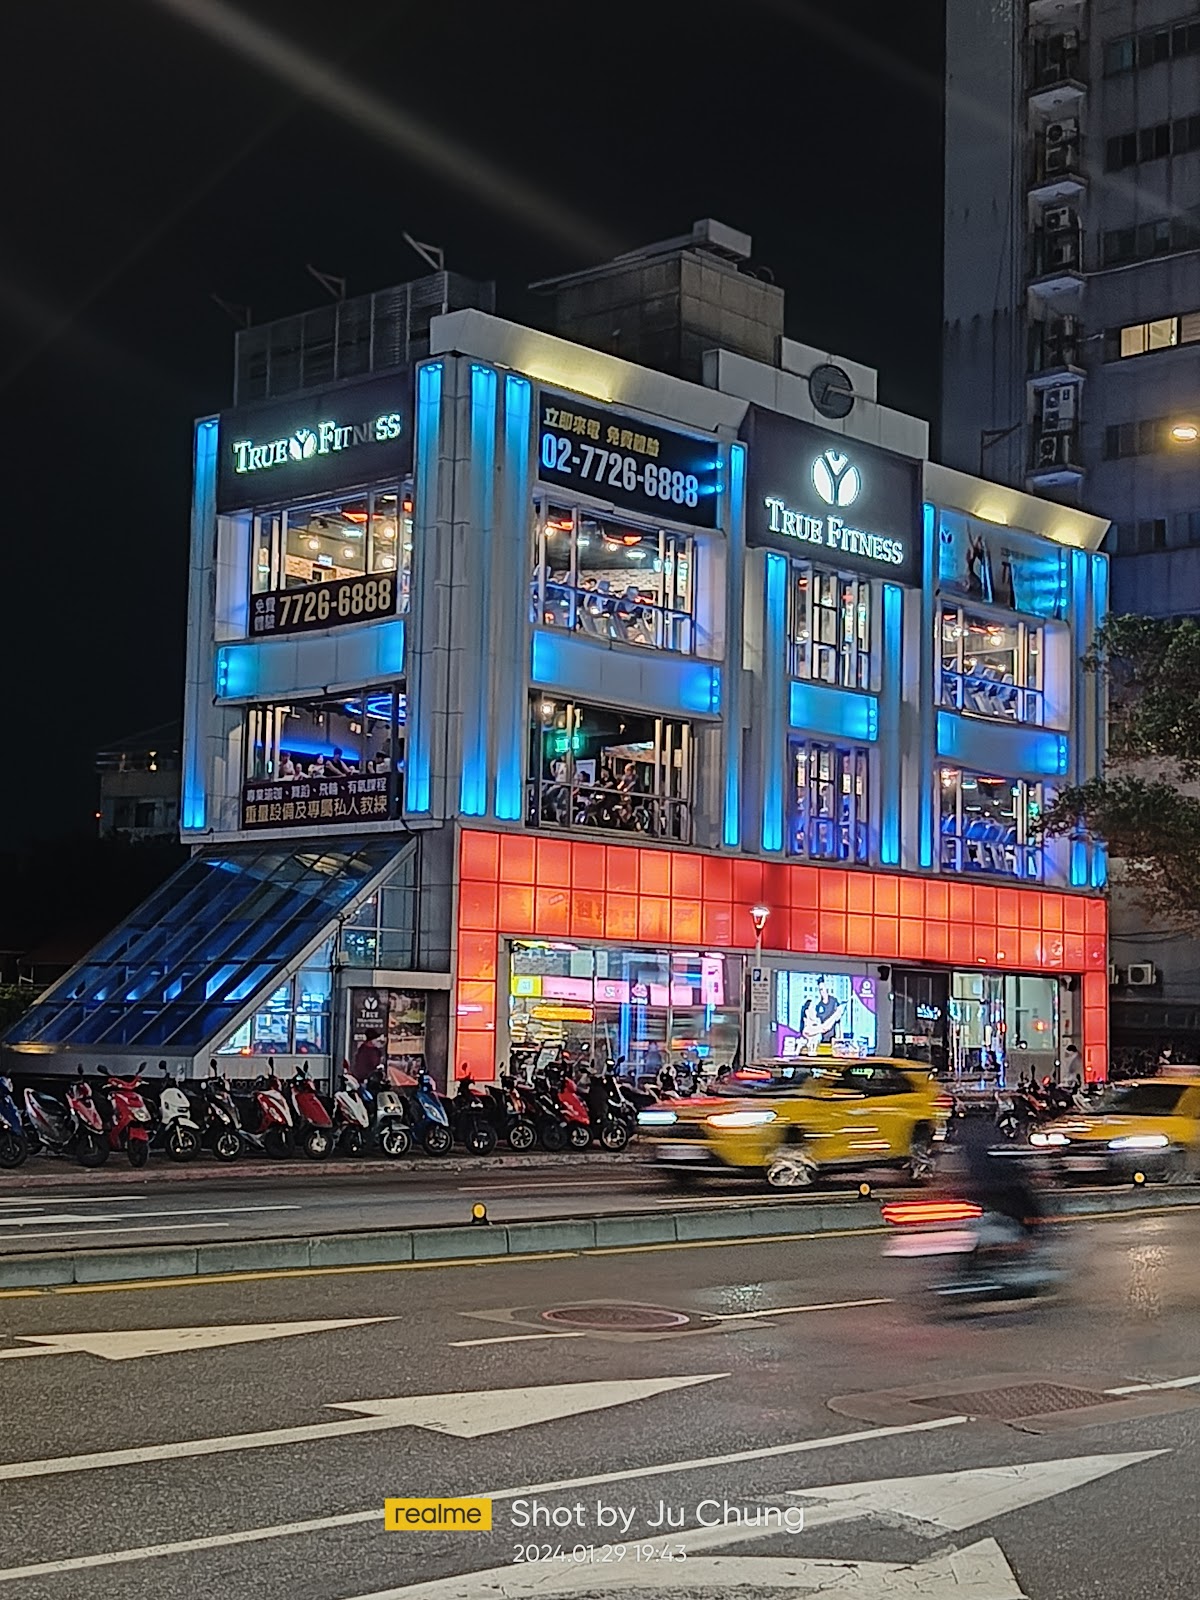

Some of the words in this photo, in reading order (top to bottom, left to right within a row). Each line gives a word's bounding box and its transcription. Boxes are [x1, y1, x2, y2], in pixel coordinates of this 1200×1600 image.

[233, 438, 289, 473] TRUE
[318, 413, 401, 455] FITNESS
[543, 407, 600, 440] 立即來電
[606, 425, 660, 458] 免費體驗
[542, 433, 699, 508] 02-7726-6888
[764, 496, 823, 545] TRUE
[826, 515, 904, 565] FITNESS
[279, 578, 391, 626] 7726-6888
